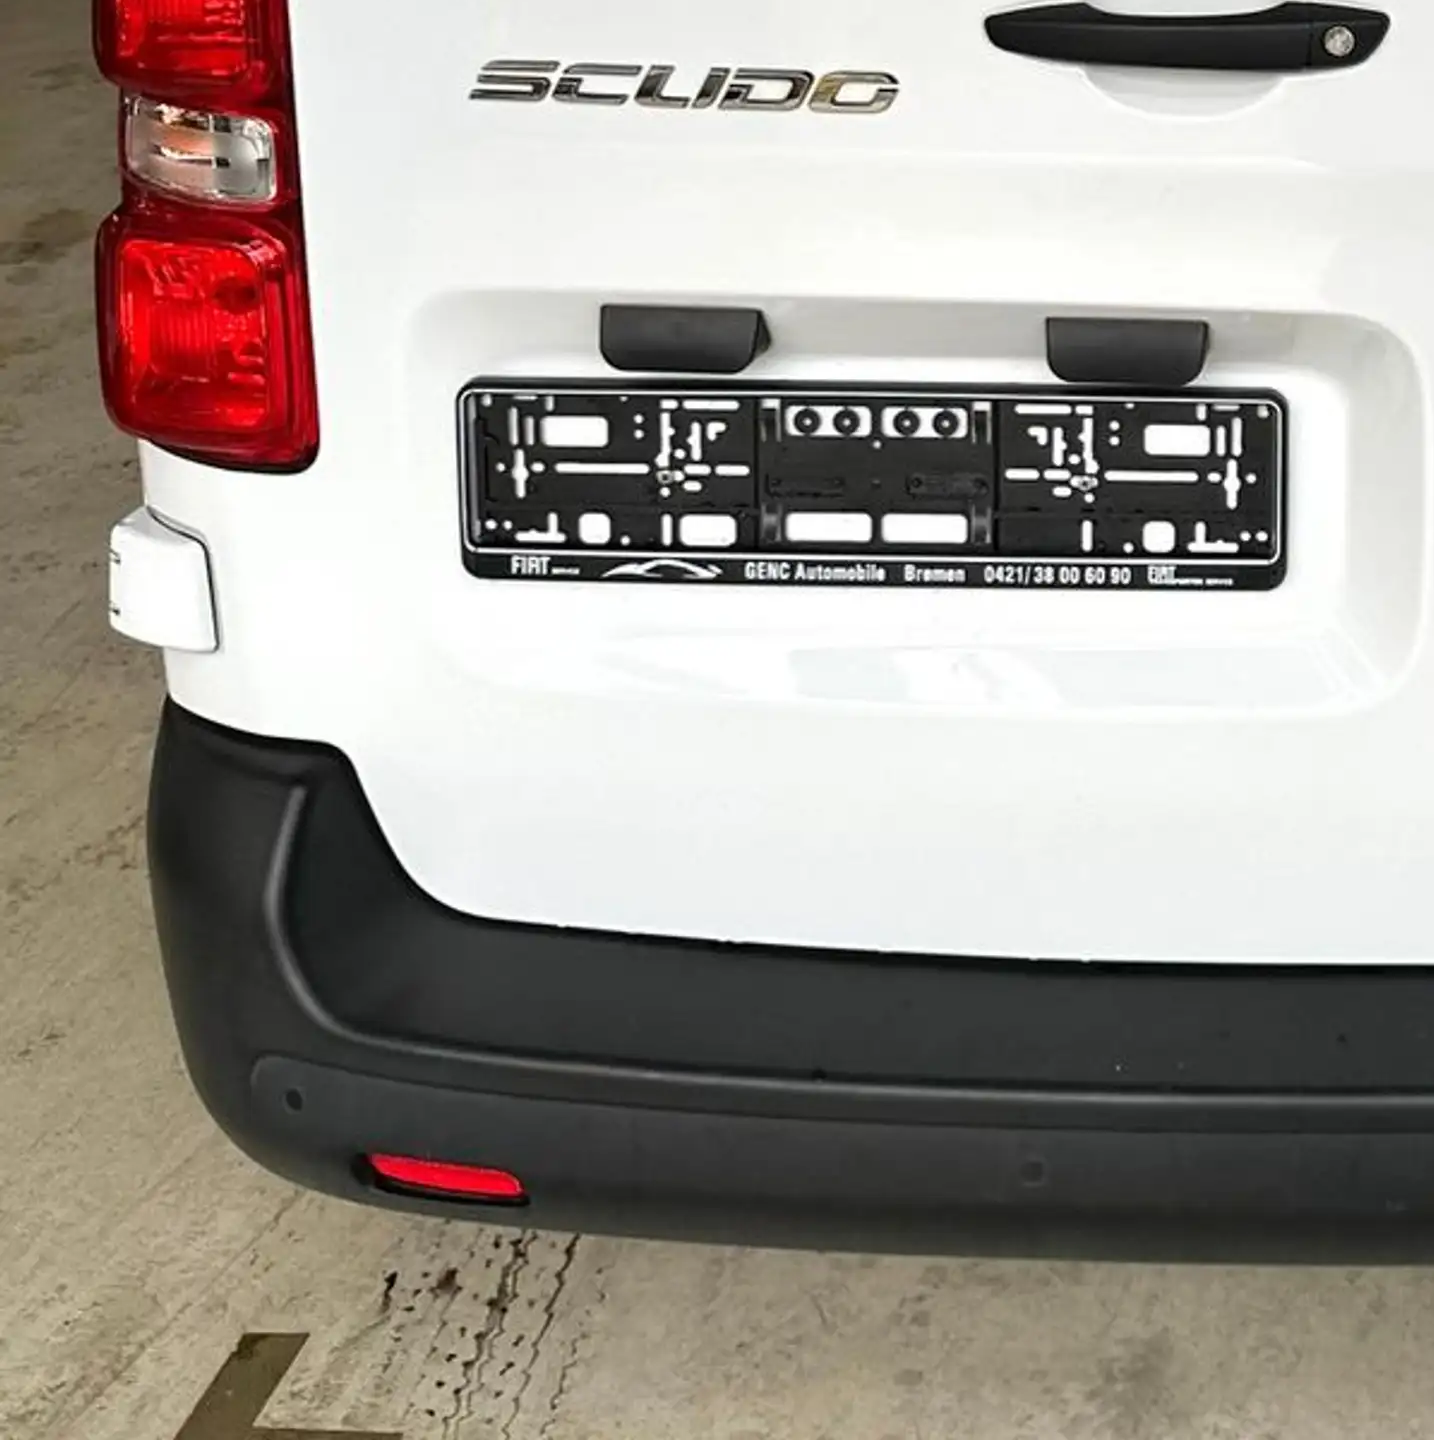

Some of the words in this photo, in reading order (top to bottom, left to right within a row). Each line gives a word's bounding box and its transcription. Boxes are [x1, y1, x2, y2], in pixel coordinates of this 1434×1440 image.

[469, 59, 900, 114] SCUDO
[511, 555, 551, 575] FIAT
[744, 561, 791, 580] GENC
[794, 563, 886, 582] Automobile
[904, 564, 966, 582] Bremen
[1059, 565, 1080, 584] 00
[1084, 566, 1105, 584] 60
[1110, 566, 1132, 584] 90
